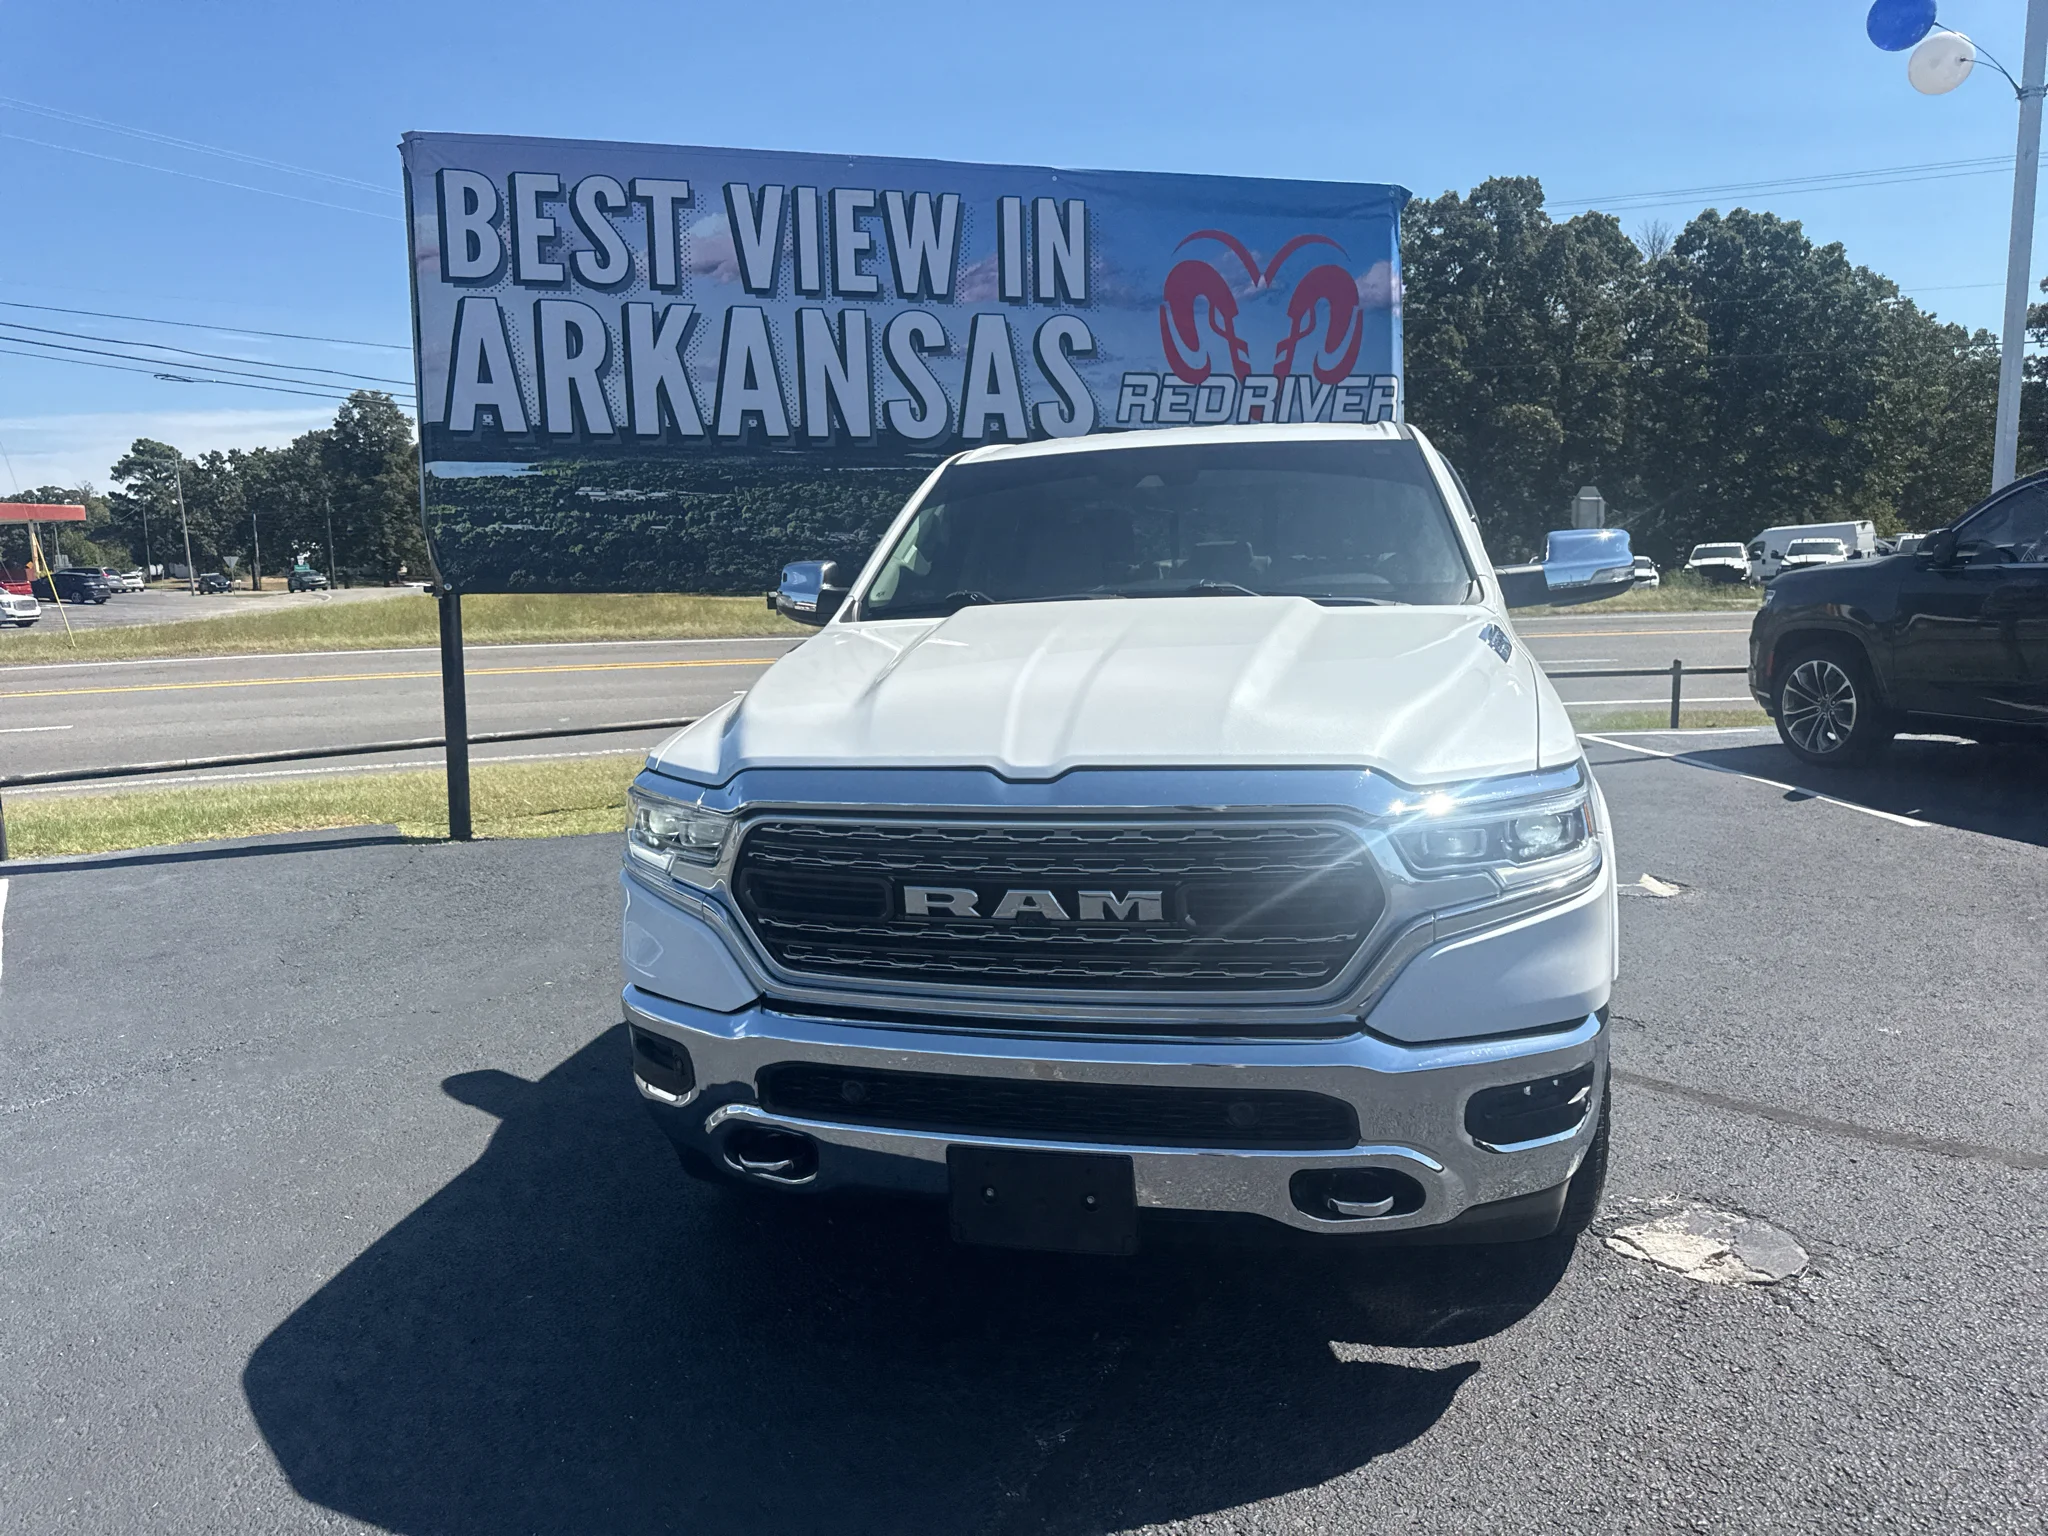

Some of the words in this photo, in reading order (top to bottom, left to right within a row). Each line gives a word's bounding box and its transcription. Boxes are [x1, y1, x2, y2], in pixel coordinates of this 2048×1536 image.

[438, 167, 691, 289] BEST
[723, 181, 961, 299] VIEW
[997, 195, 1087, 300] IN
[442, 296, 1098, 440] ARKANSAS
[903, 885, 1165, 921] RAM
